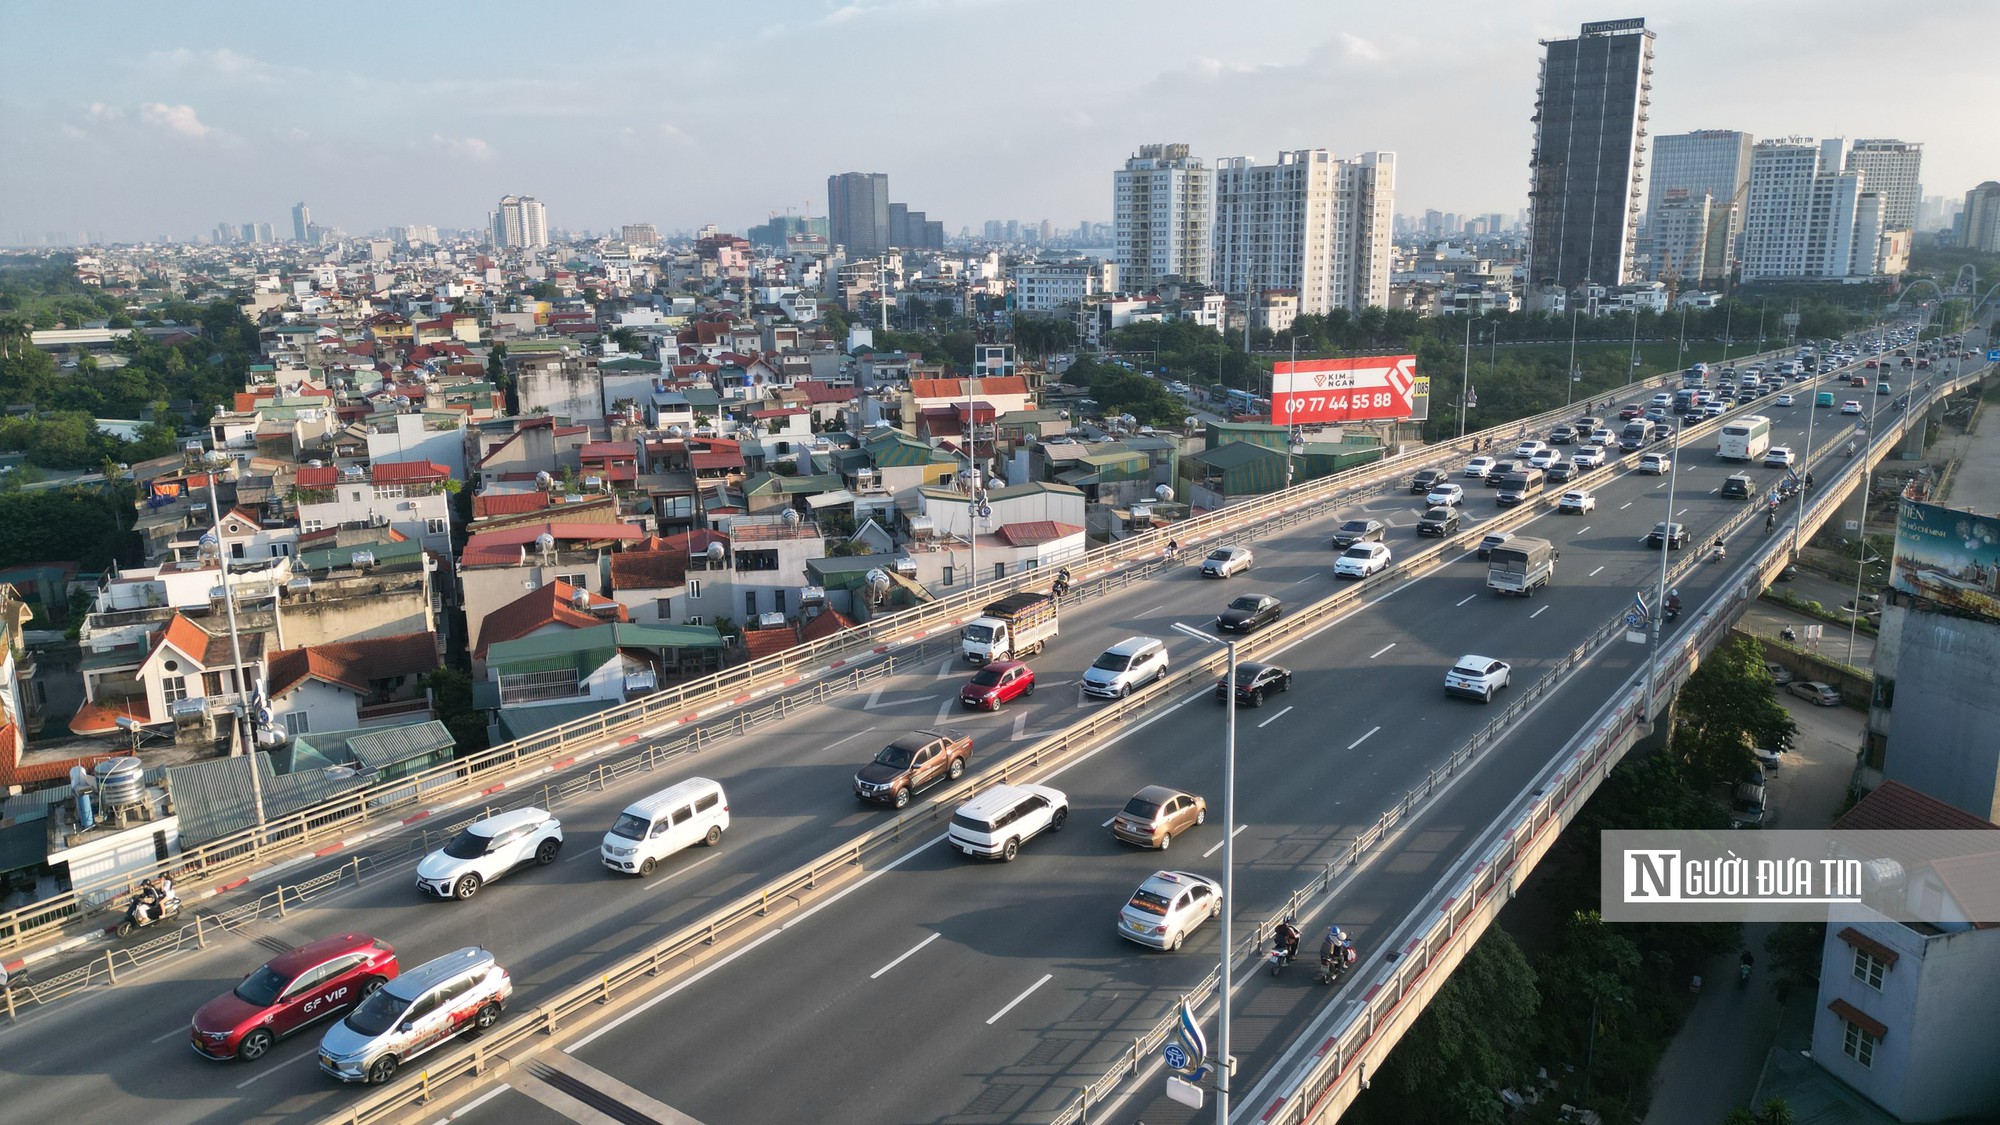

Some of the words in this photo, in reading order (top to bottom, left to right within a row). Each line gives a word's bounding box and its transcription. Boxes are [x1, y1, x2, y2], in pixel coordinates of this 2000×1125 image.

[1583, 19, 1642, 33] PentStudio
[1285, 398, 1305, 413] 09
[1309, 397, 1325, 412] 77
[1328, 395, 1348, 410] 44
[1352, 393, 1370, 409] 55
[1373, 393, 1391, 407] 88
[303, 998, 322, 1013] GF
[325, 987, 348, 1003] VIP
